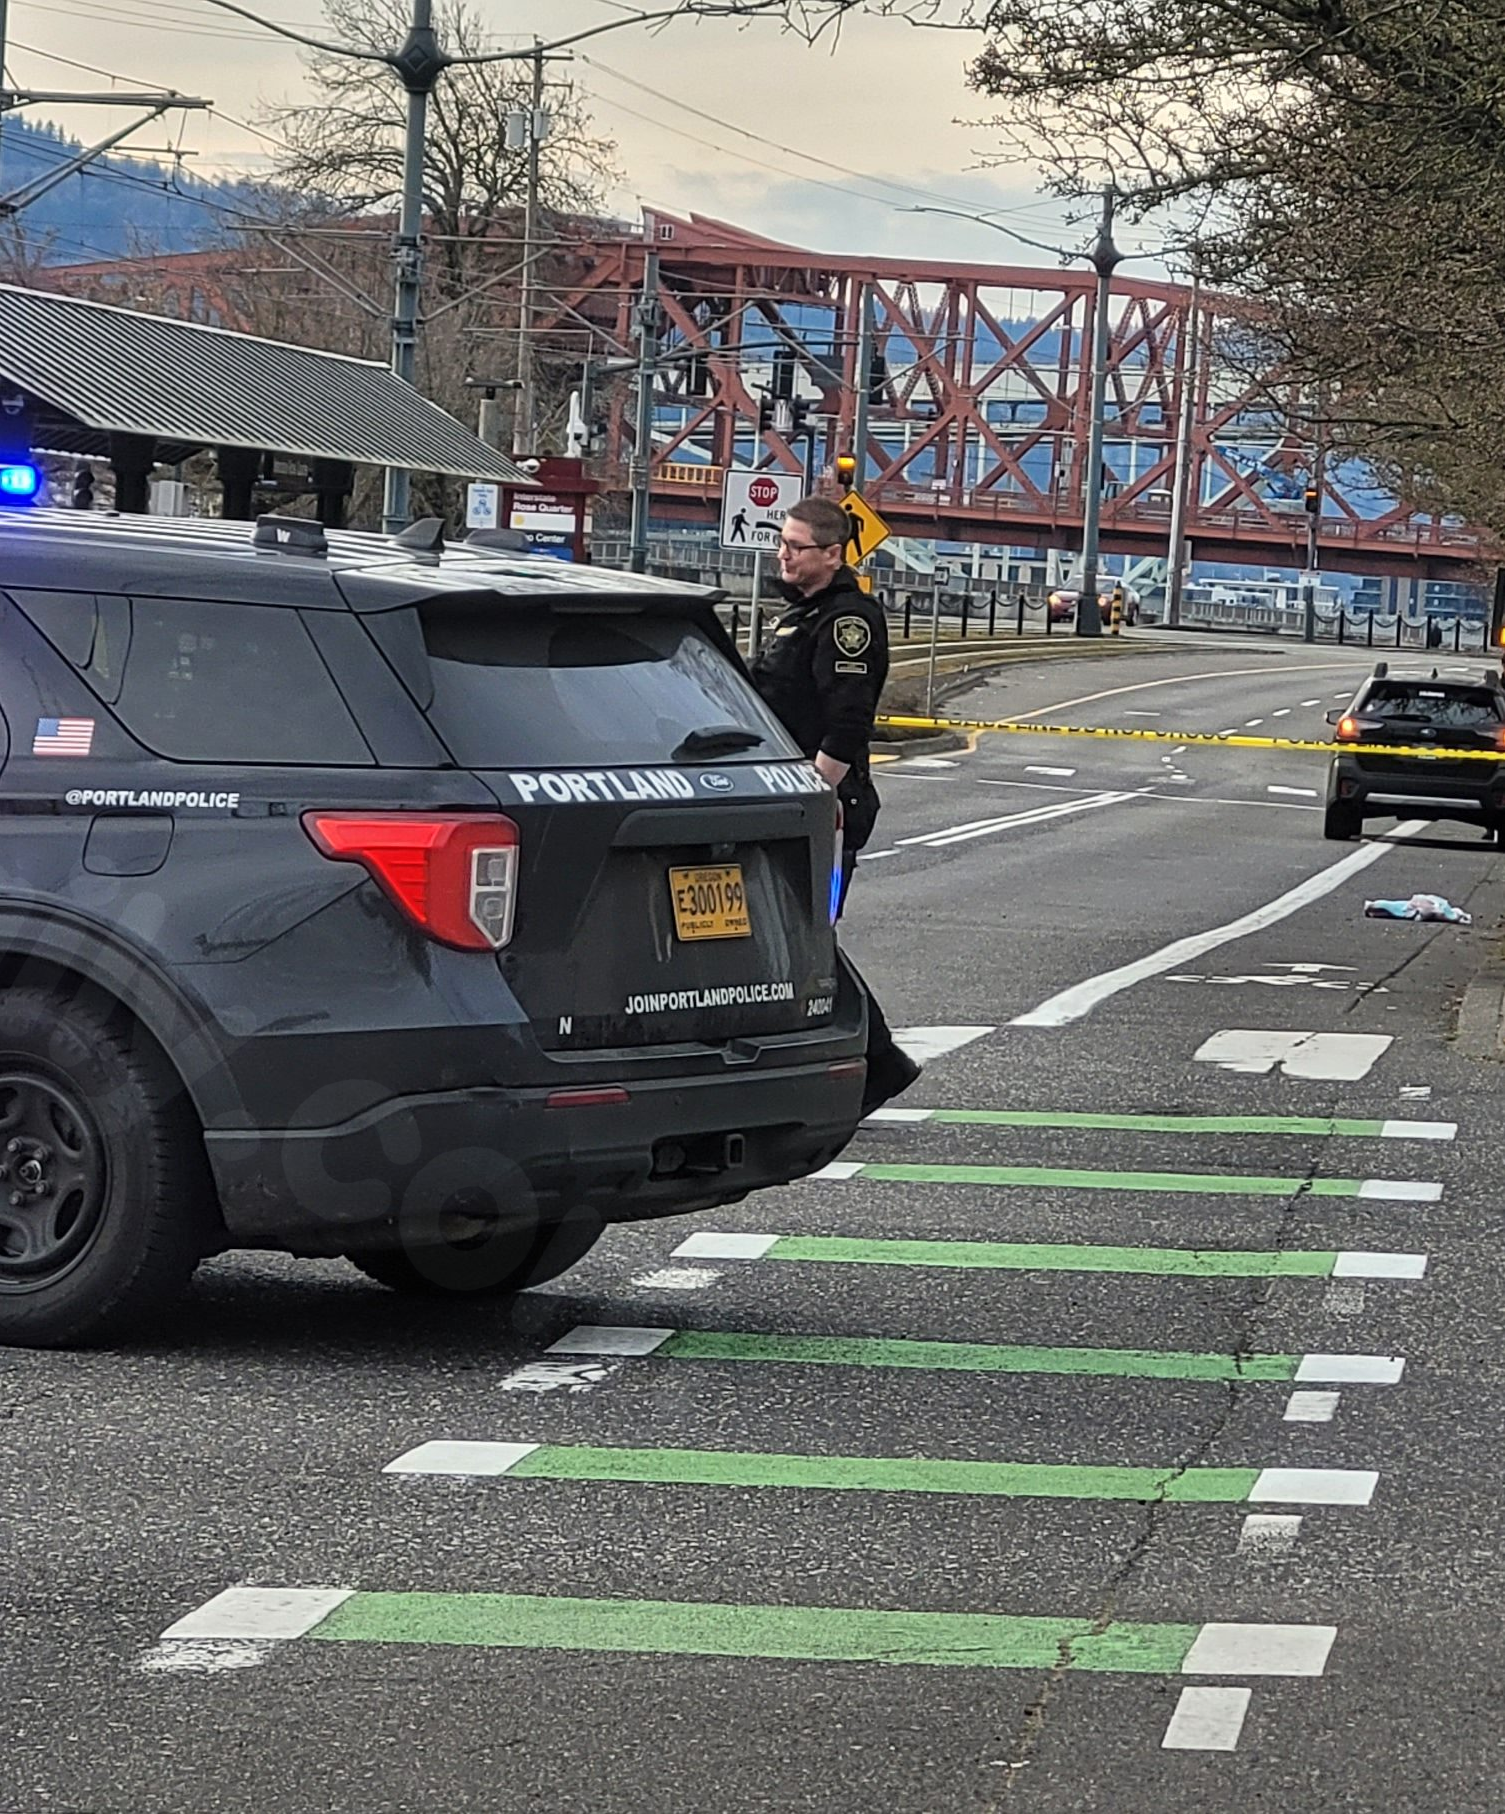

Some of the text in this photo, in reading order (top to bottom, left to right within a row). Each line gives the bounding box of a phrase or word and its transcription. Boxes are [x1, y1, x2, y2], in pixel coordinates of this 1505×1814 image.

[750, 485, 777, 499] STOP
[513, 502, 574, 513] Rose Quarter
[767, 509, 786, 520] HER
[536, 533, 566, 543] Center
[751, 531, 770, 542] FOR
[508, 765, 831, 803] PORTLAND POLICE
[65, 789, 240, 808] @PORTLANDPOLICE
[677, 882, 742, 915] E300199
[625, 982, 794, 1015] JOINPORTLANDPOLICE.COM
[558, 1016, 573, 1035] N
